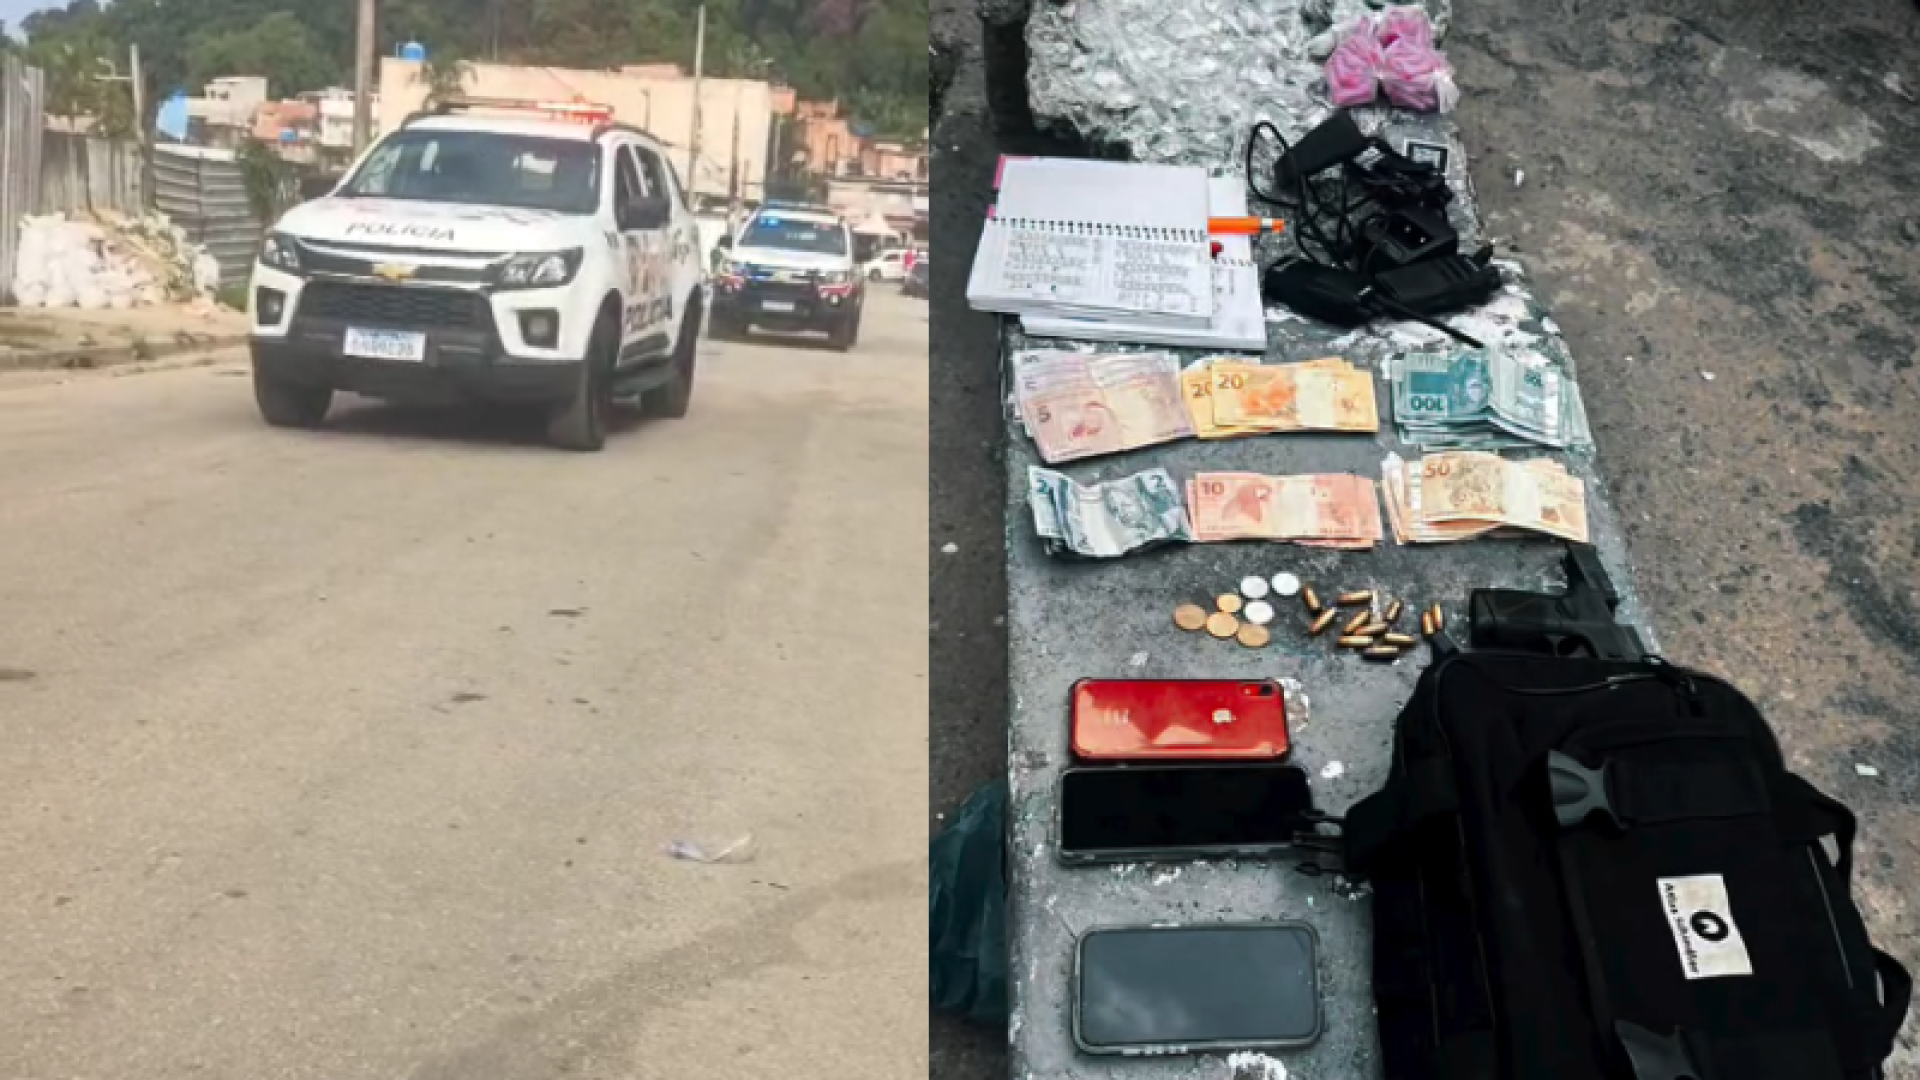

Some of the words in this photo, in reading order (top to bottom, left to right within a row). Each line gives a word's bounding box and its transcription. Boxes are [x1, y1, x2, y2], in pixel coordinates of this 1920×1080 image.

[1217, 373, 1244, 391] 20
[1410, 395, 1446, 412] 100
[1037, 404, 1052, 423] 5
[1424, 462, 1452, 479] 50
[1201, 481, 1225, 496] 10
